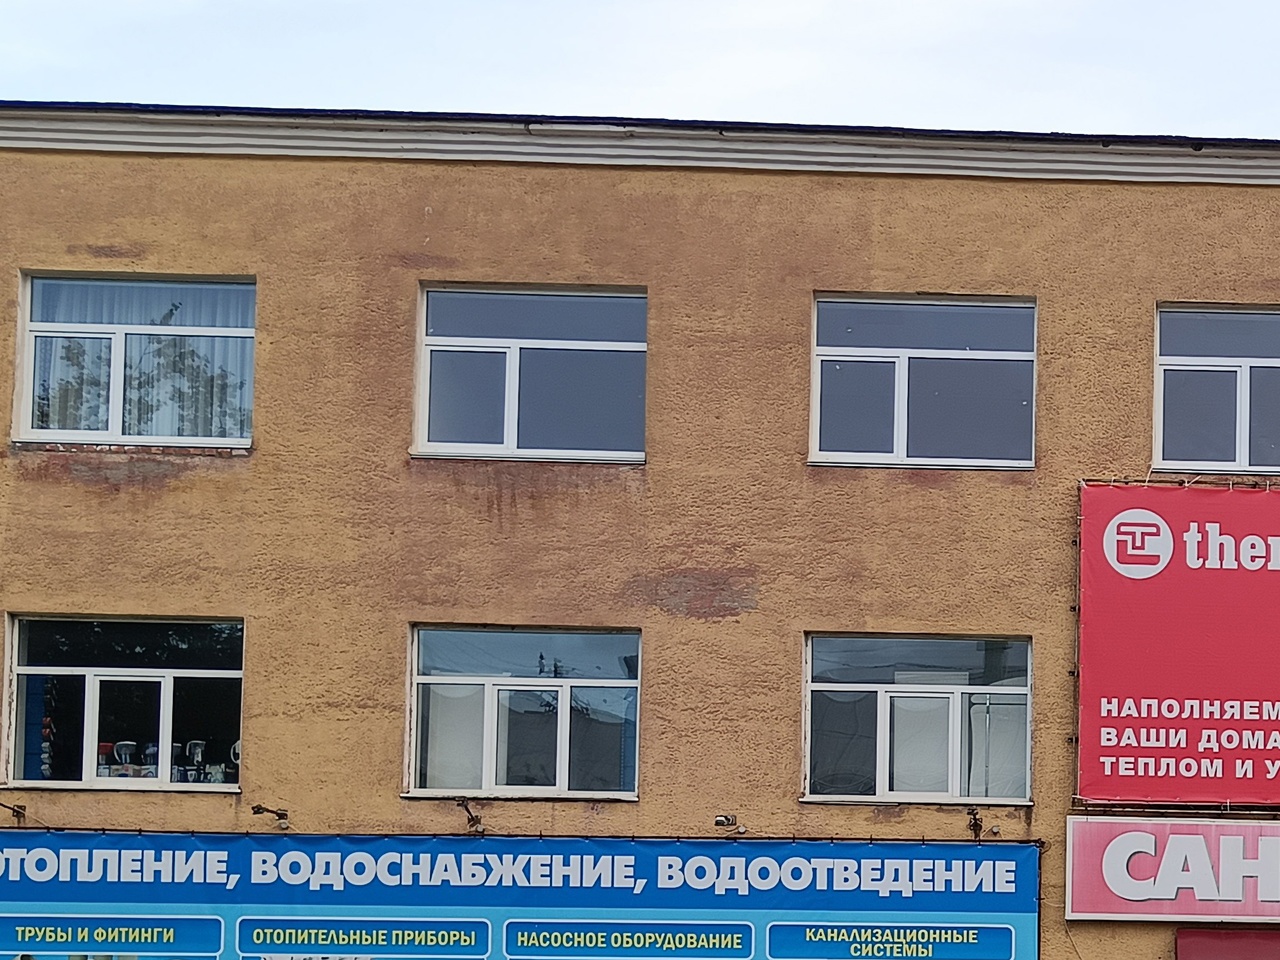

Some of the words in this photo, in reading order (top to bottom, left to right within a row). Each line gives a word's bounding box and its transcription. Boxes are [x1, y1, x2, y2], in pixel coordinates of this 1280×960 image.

[1100, 728, 1187, 748] ВАШИ
[1100, 756, 1223, 778] ТЕПЛОМ
[1235, 759, 1253, 778] И
[0, 848, 241, 890] ТОПЛЕНИЕ,
[251, 850, 646, 893] ВОДОСНАБЖЕНИЕ,
[657, 856, 1017, 896] ВОДООТВЕДЕНИЕ
[15, 926, 74, 944] ТРУБЫ
[78, 926, 89, 943] И
[93, 926, 175, 944] ФИТИНГИ
[252, 928, 388, 946] ОТОПИТЕЛЬНЫЕ
[392, 930, 476, 947] ПРИБОРЫ
[517, 931, 607, 949] НАСОСНОЕ
[610, 932, 743, 952] ОБОРУДОВАНИЕ
[805, 928, 978, 946] КАНАЛИЗАЦИОННЫЕ
[850, 942, 933, 957] СИСТЕМЫ
